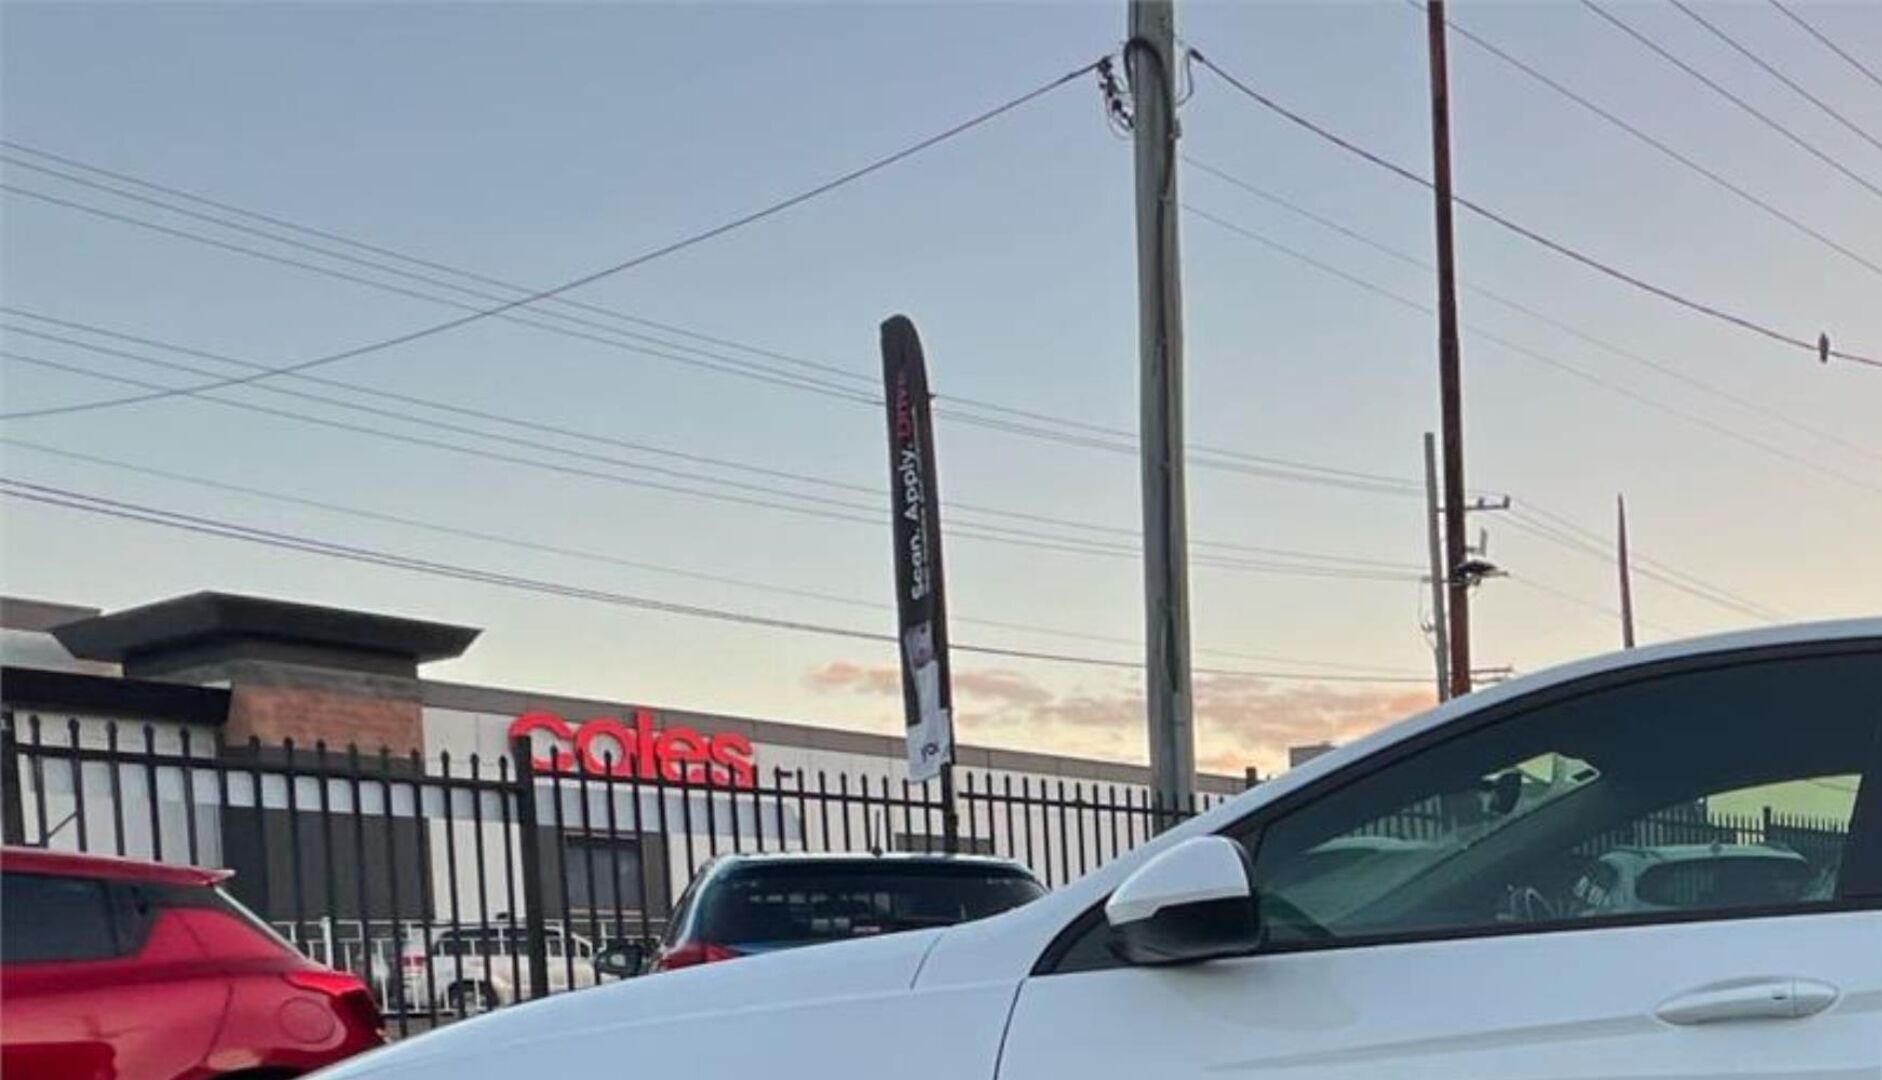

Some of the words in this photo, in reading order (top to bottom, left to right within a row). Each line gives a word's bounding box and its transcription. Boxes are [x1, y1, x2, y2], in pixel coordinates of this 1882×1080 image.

[899, 443, 919, 522] Apply.
[910, 527, 925, 600] Scan.
[508, 707, 754, 789] coles
